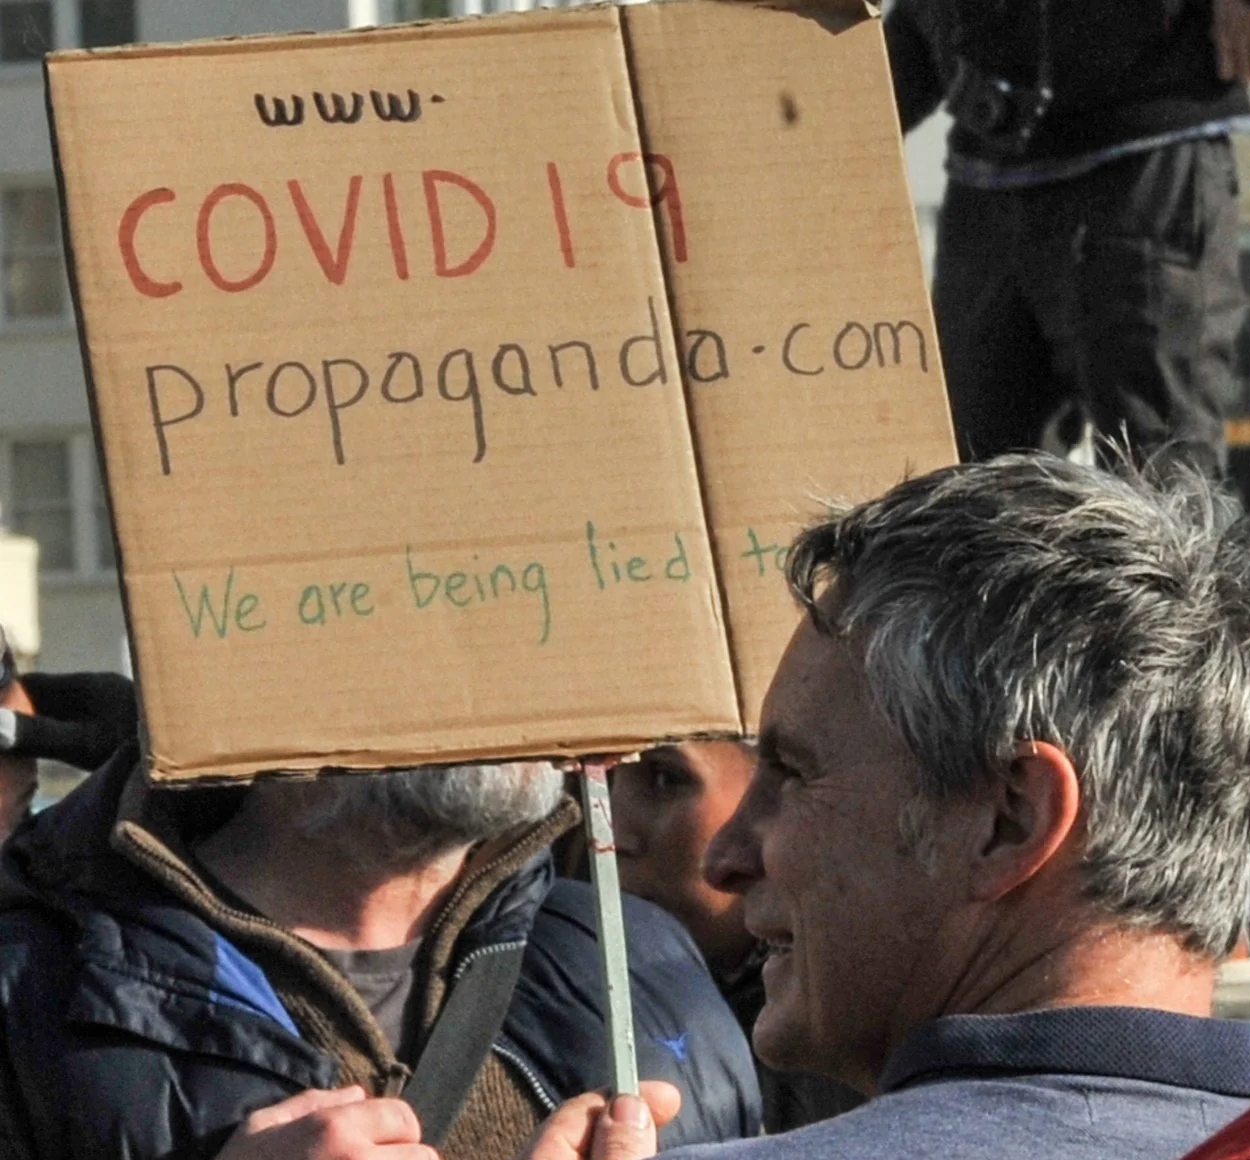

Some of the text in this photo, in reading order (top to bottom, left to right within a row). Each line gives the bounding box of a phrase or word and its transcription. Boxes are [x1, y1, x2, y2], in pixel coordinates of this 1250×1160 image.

[253, 89, 446, 127] www.
[119, 152, 688, 298] COVID 19
[172, 566, 268, 641] We
[297, 582, 372, 626] are
[407, 547, 549, 645] being
[586, 522, 691, 592] lied
